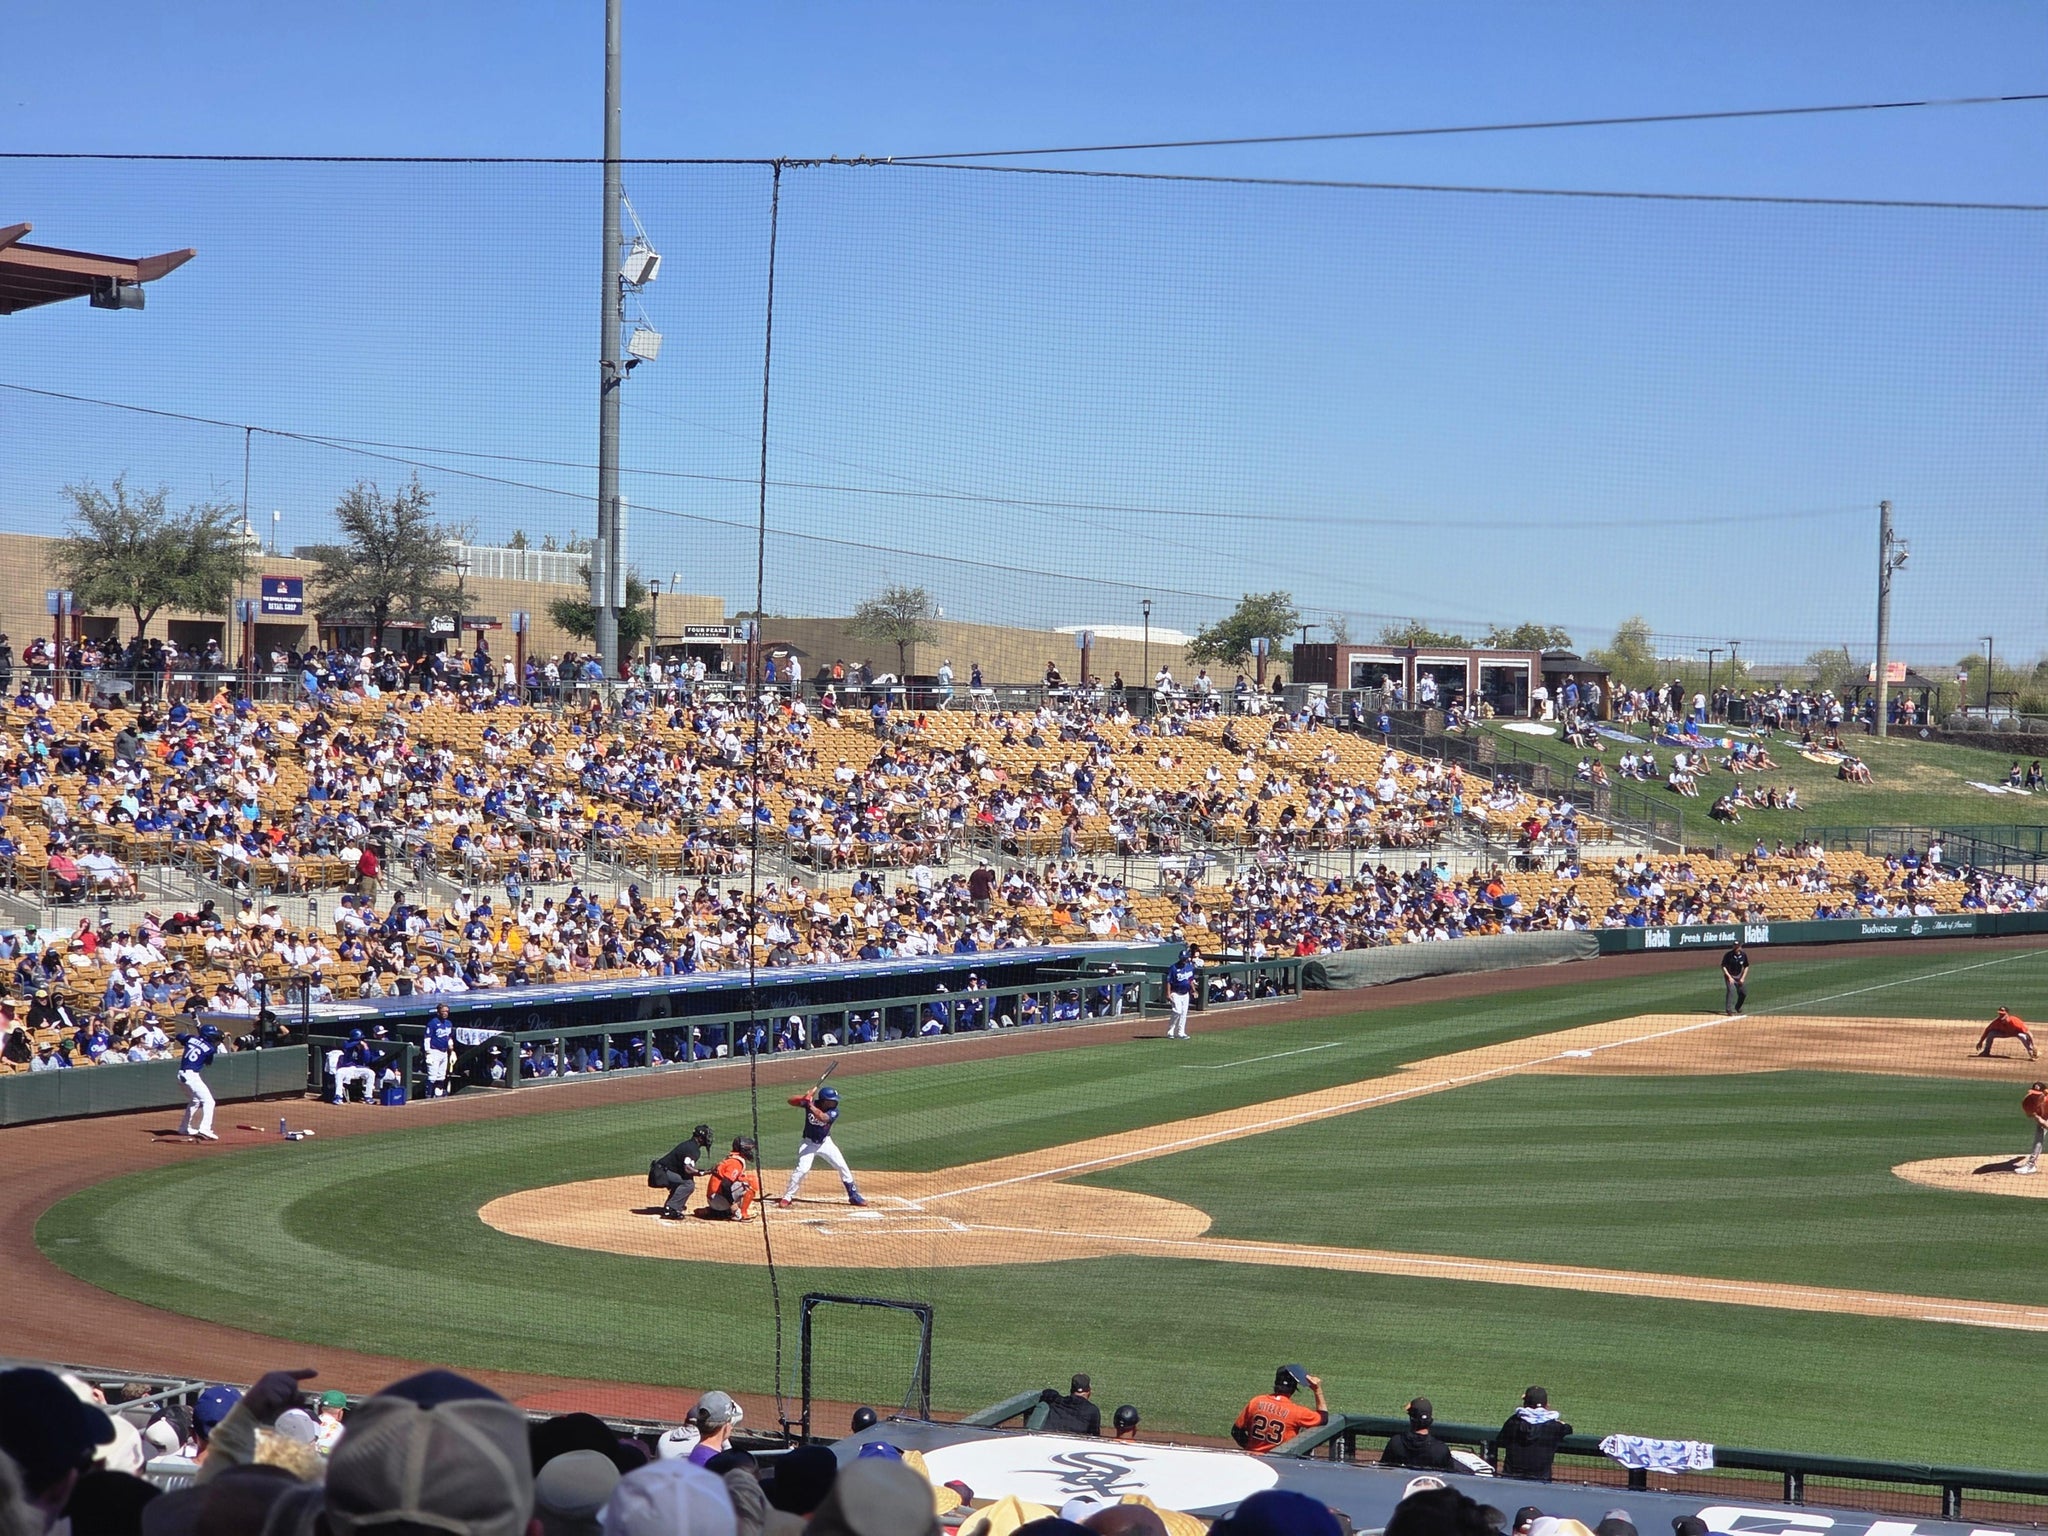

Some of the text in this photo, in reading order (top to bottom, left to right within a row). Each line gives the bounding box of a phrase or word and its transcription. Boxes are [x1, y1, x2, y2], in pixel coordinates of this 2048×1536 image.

[1644, 925, 1769, 948] Habit fresh like that. Habit
[1861, 923, 1898, 934] Budweiser
[184, 1044, 202, 1062] 76
[1251, 1414, 1285, 1445] 23
